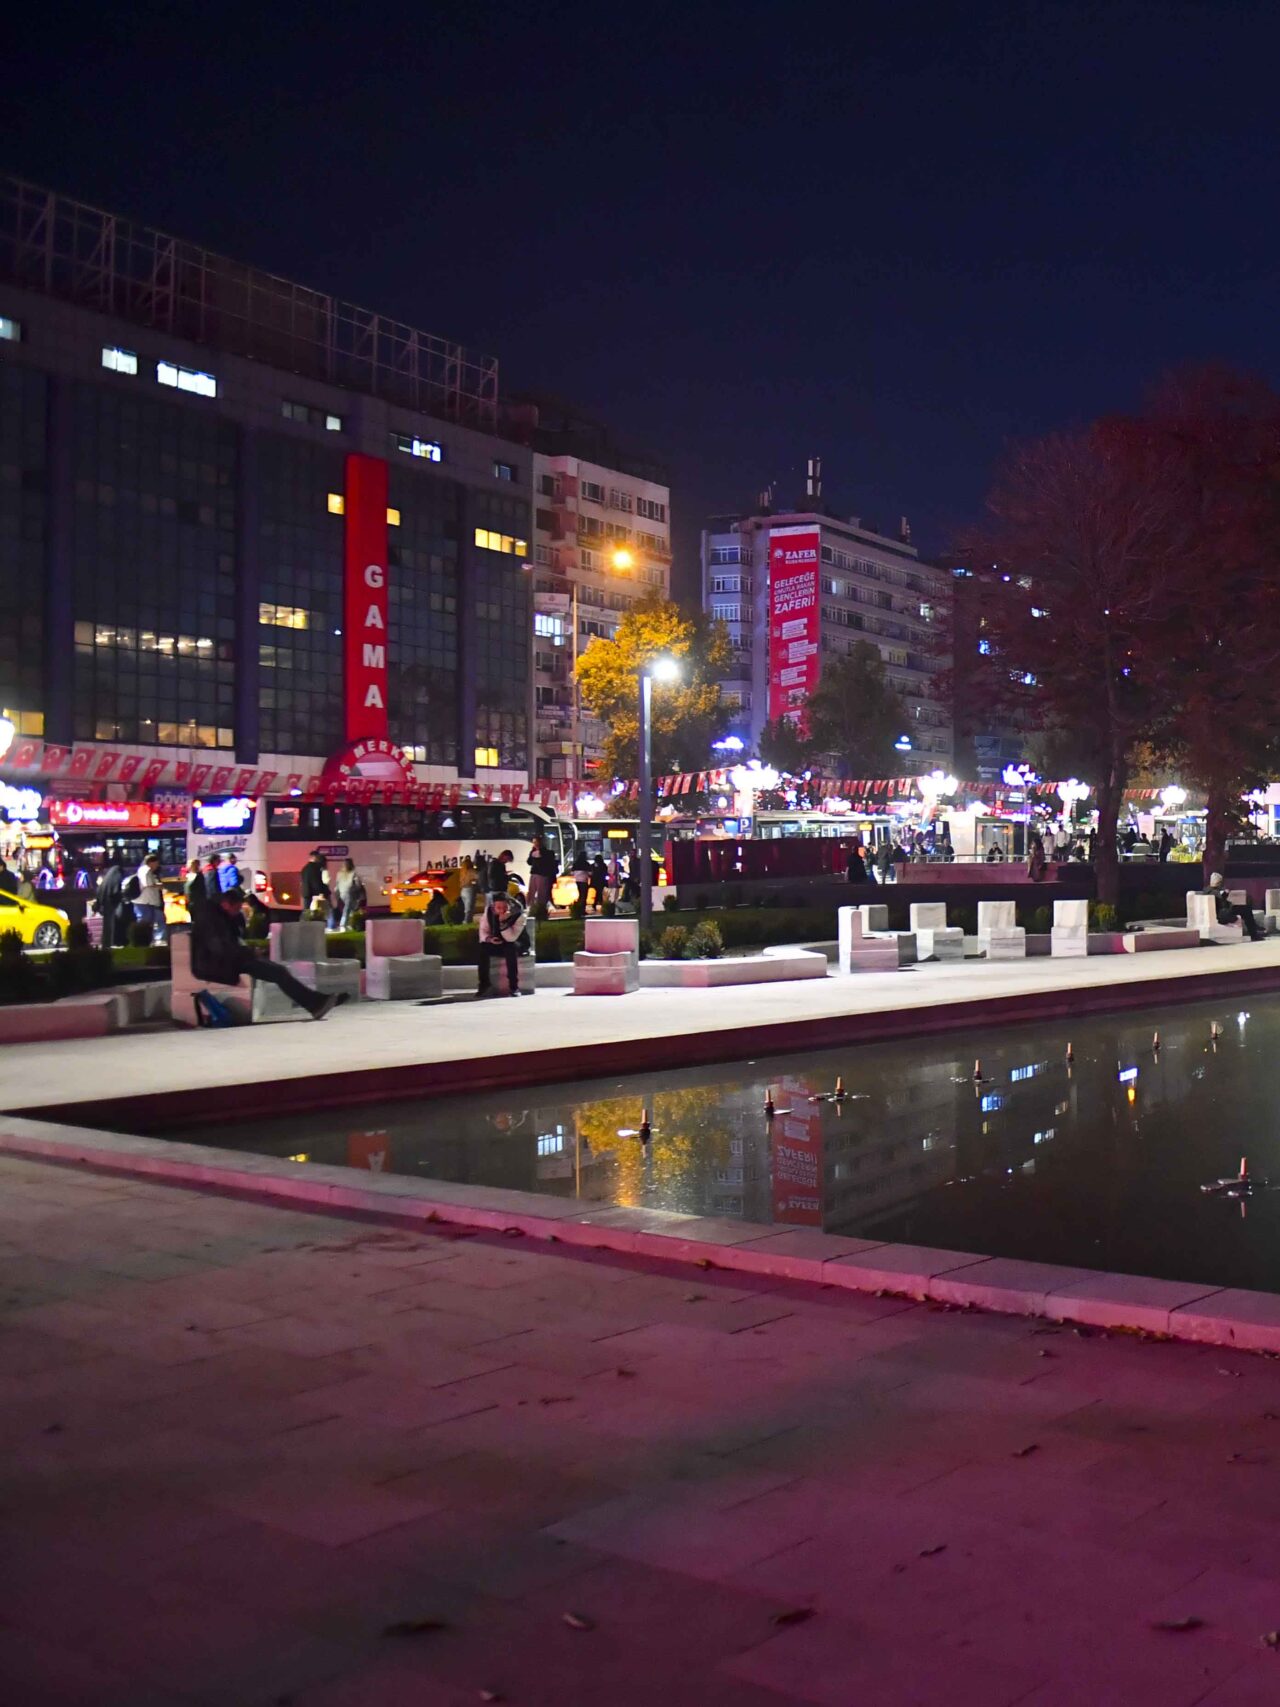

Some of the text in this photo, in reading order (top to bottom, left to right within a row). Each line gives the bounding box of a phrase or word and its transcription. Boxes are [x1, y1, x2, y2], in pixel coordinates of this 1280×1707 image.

[785, 549, 816, 560] ZAFER
[774, 571, 815, 589] GELECEĞE
[774, 595, 815, 614] ZAFERİ!
[363, 565, 385, 708] GAMA
[740, 818, 749, 833] P
